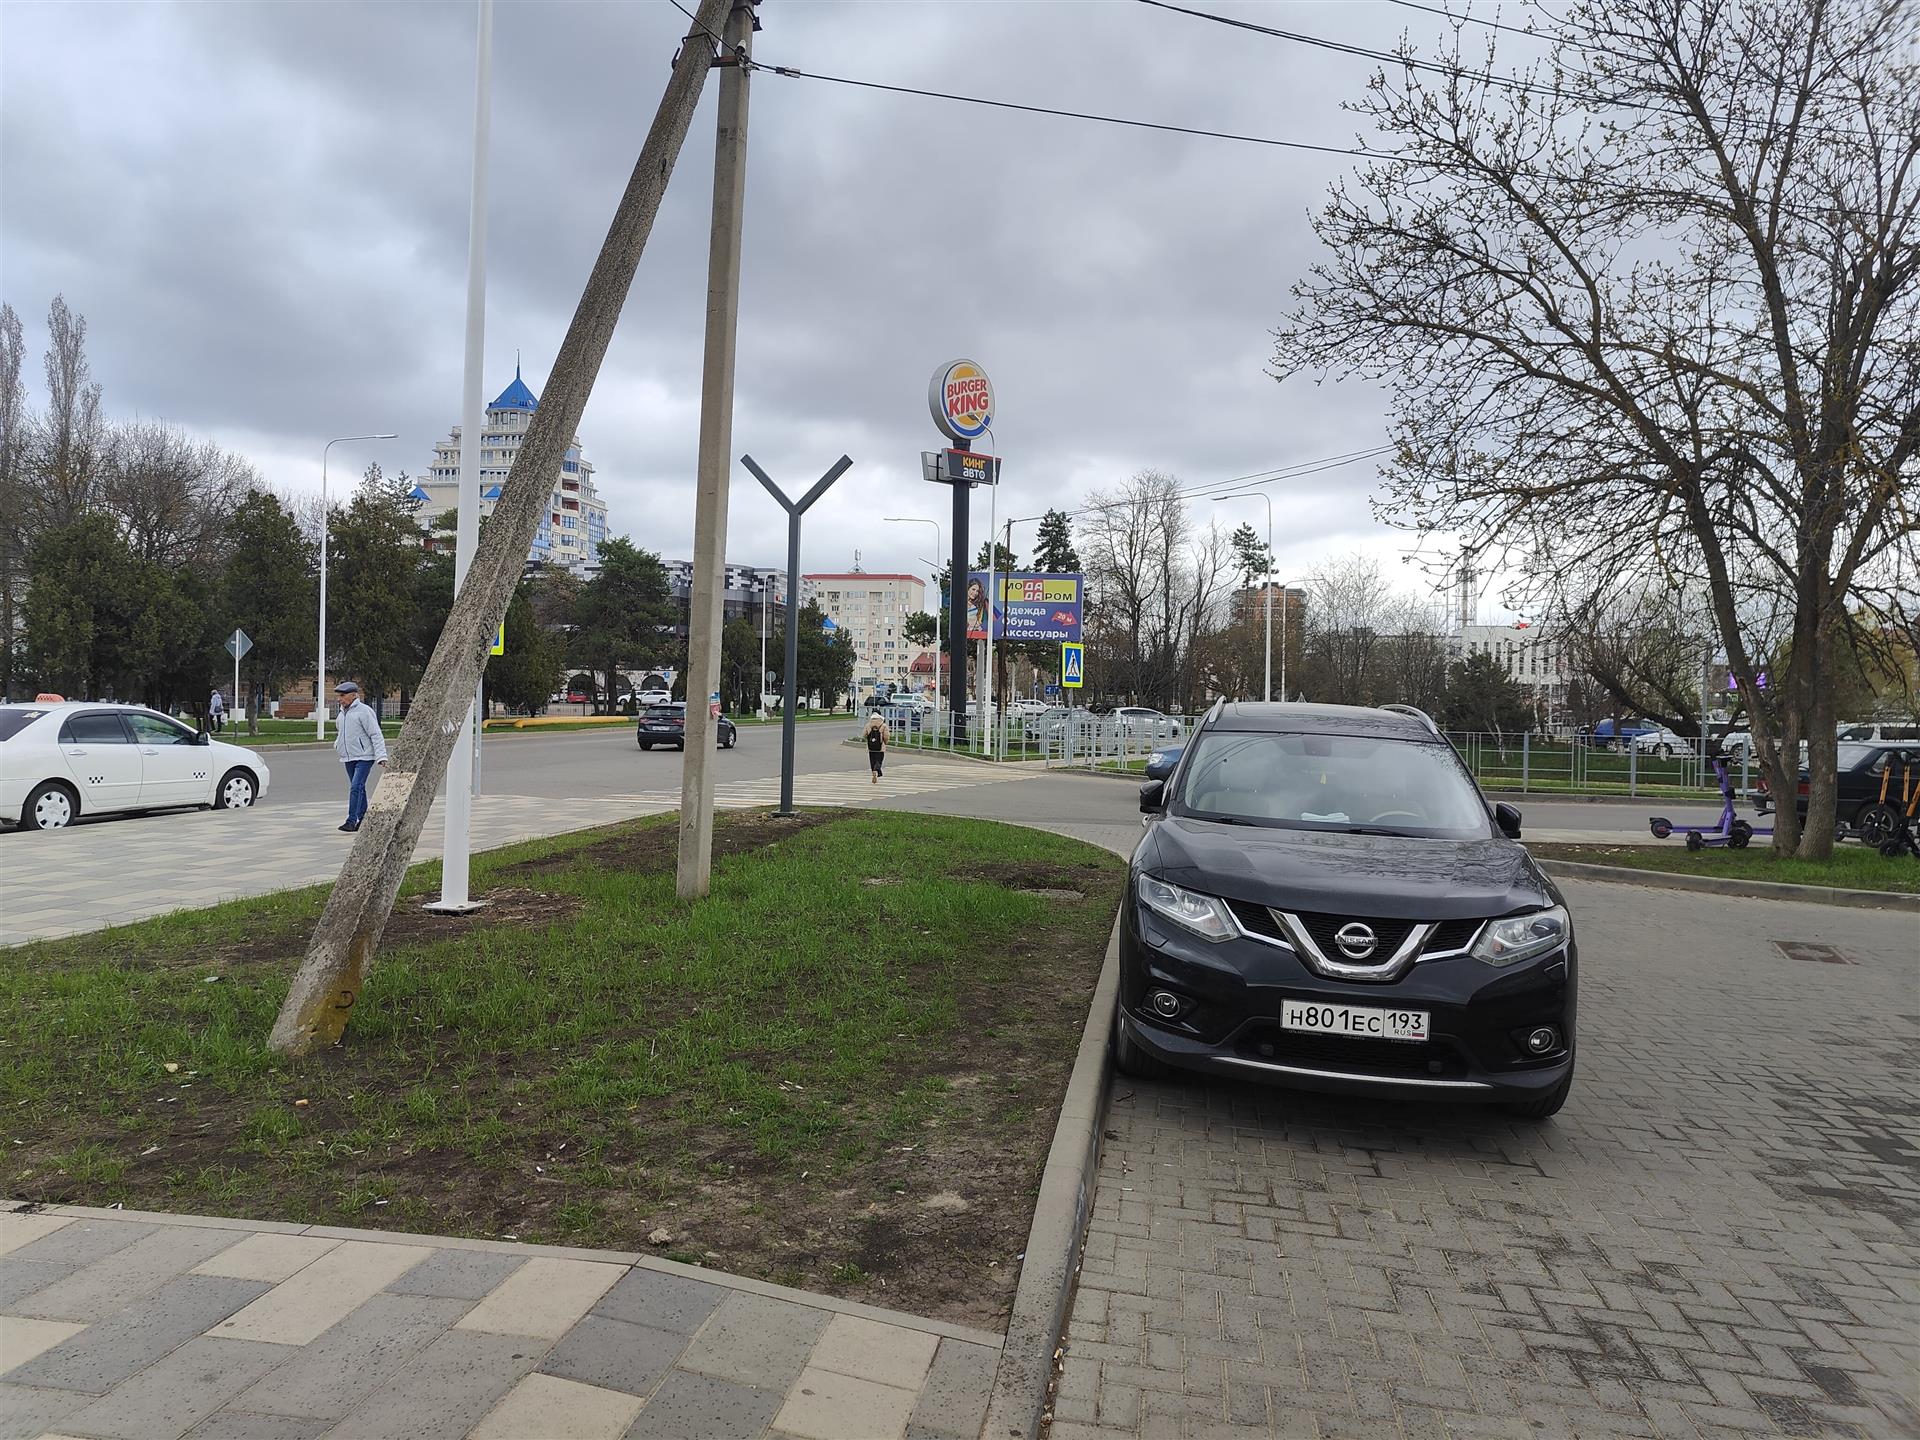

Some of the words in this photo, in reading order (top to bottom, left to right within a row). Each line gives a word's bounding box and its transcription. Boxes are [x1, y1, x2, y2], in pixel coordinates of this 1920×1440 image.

[947, 379, 987, 398] BURGER
[949, 392, 989, 417] KING
[962, 456, 986, 469] КИНГ
[1339, 936, 1374, 945] NISSAN
[1387, 1012, 1422, 1030] 193
[1394, 1028, 1412, 1037] RUS
